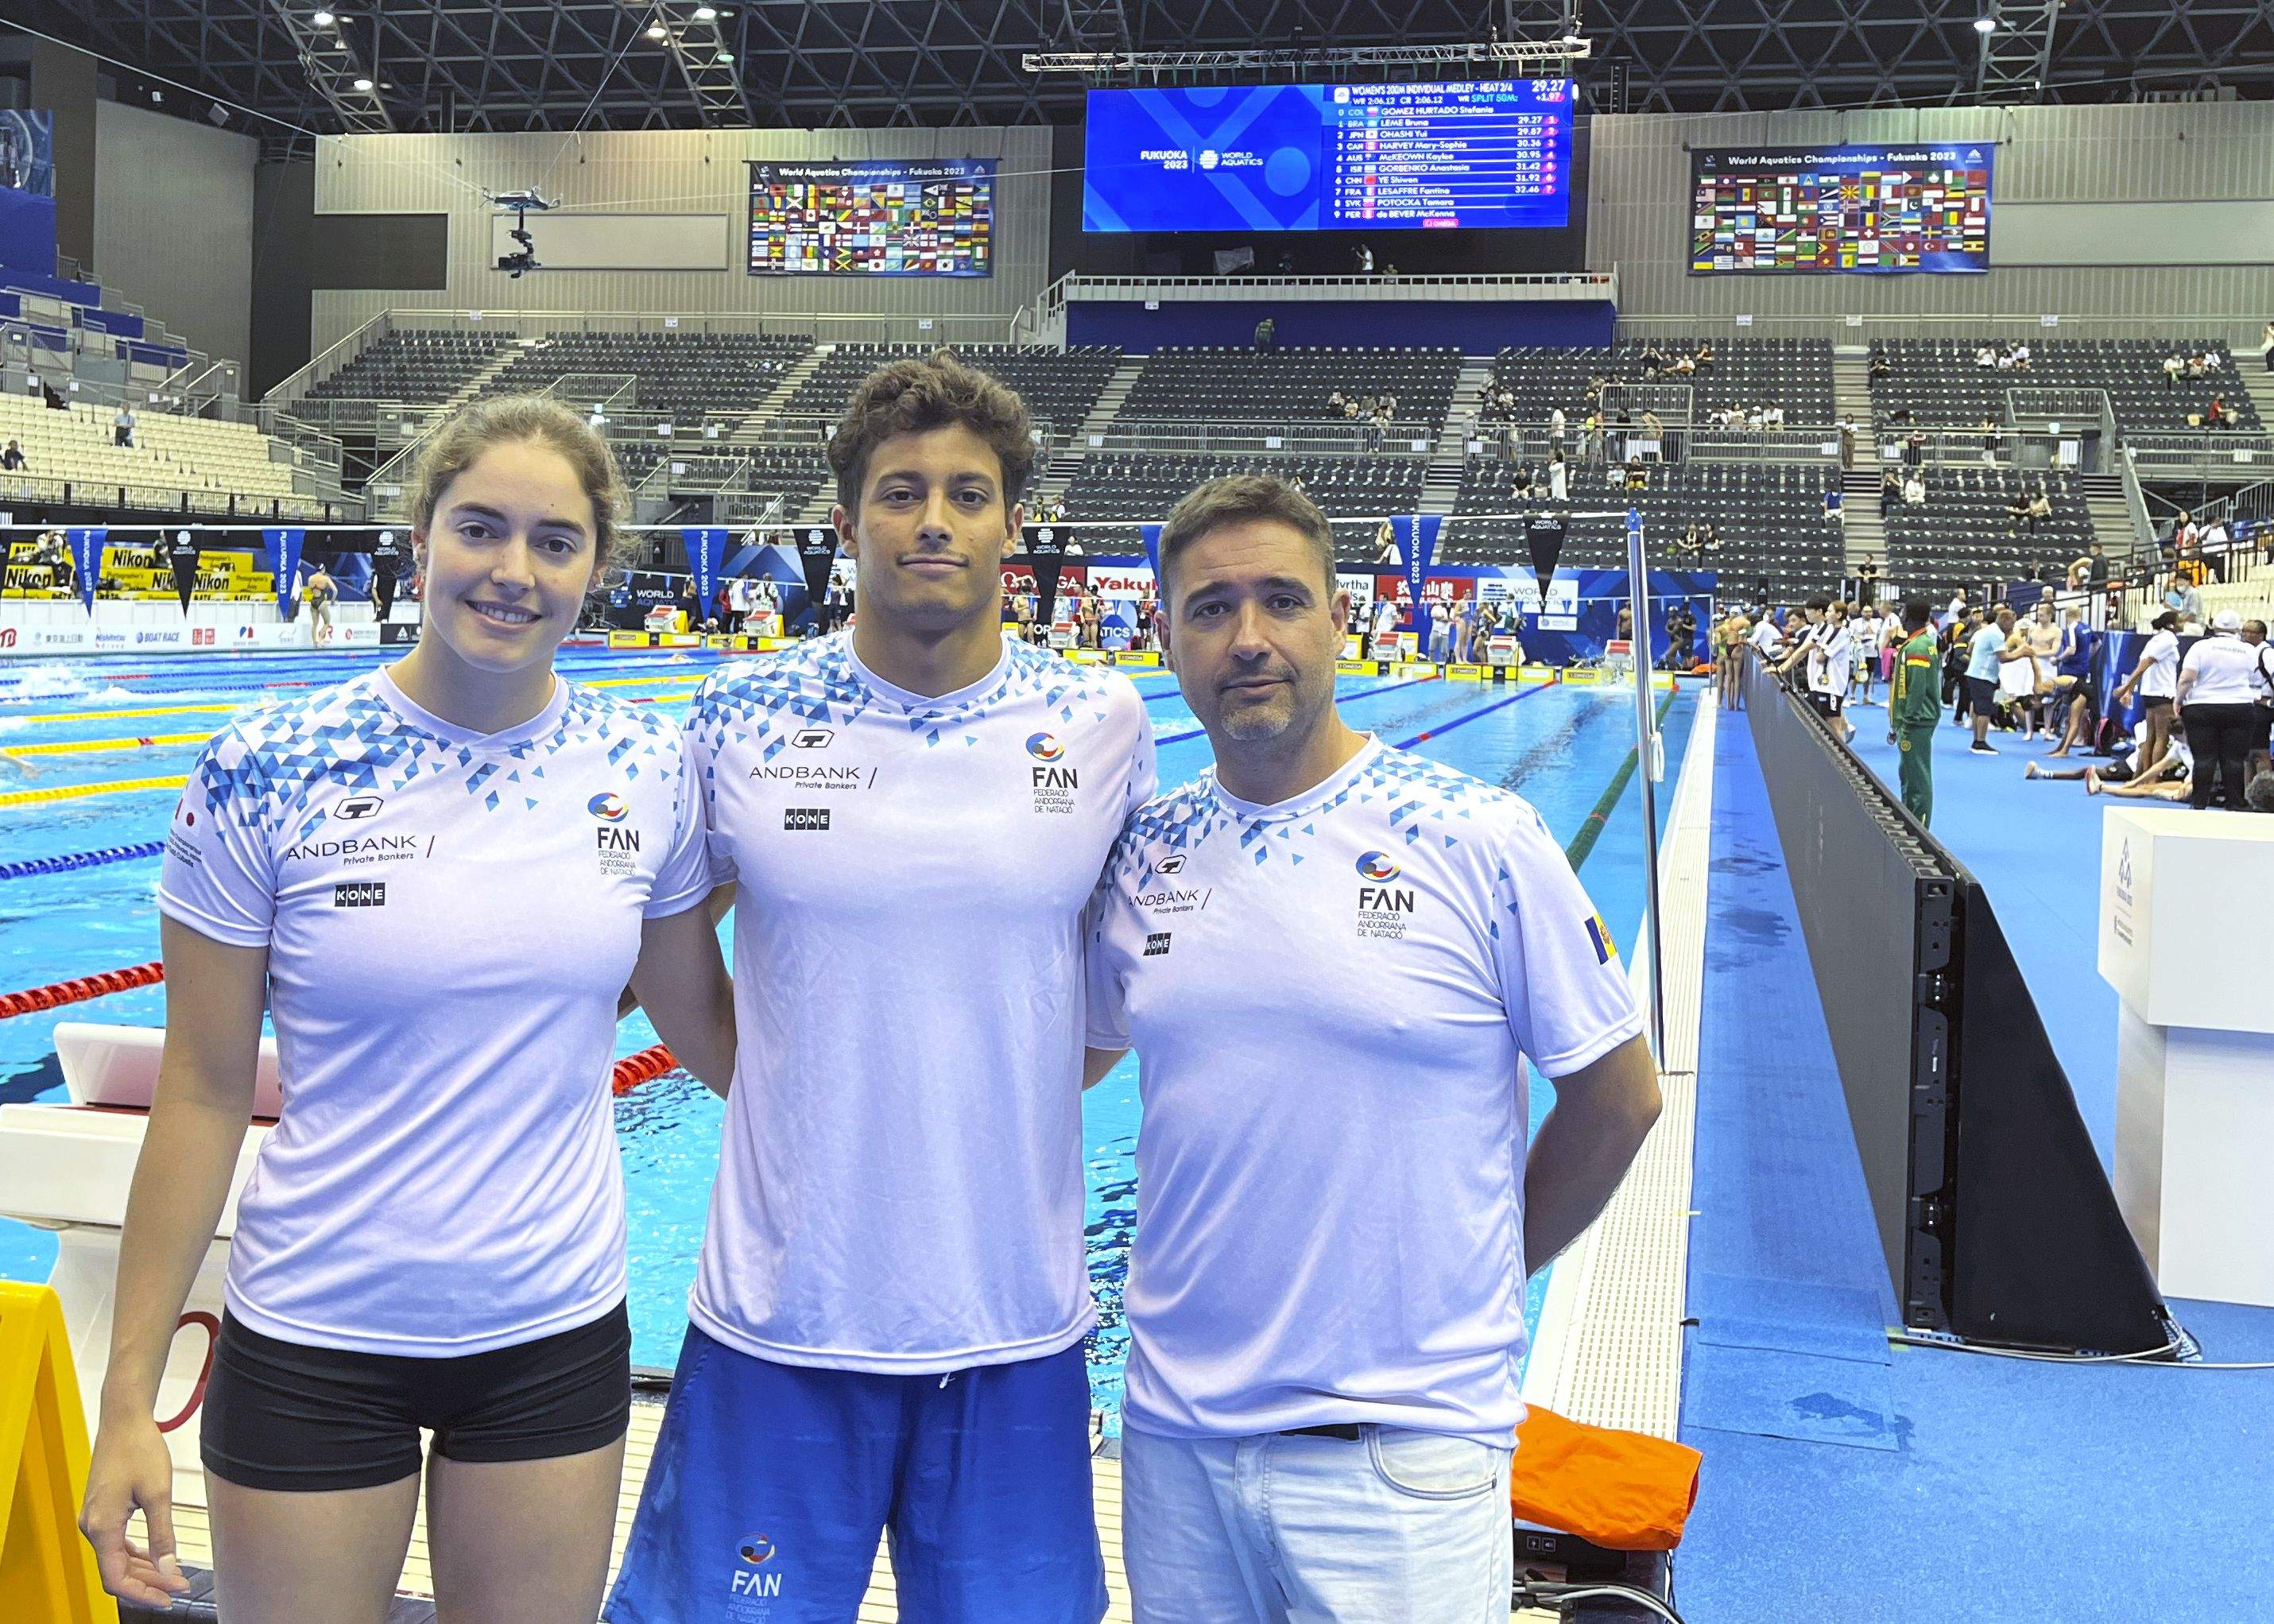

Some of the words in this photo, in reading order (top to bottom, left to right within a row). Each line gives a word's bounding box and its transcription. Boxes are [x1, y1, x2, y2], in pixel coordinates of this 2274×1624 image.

[1447, 83, 1475, 93] MEDLEY
[1480, 83, 1499, 92] HEAT
[1500, 83, 1513, 91] 2/4
[1532, 79, 1565, 91] 29.27
[1471, 94, 1494, 103] SPLIT
[1416, 107, 1459, 115] HURTADO
[1140, 150, 1187, 160] FUKUOKA
[1729, 156, 1757, 165] World
[1760, 156, 1801, 165] Aquatics
[1804, 154, 1877, 165] Championships
[1930, 152, 1956, 161] 2023
[779, 168, 804, 176] World
[805, 169, 839, 177] Aquatics
[842, 168, 901, 177] Championships
[909, 167, 942, 176] Fukuoka
[1164, 161, 1187, 169] 2023
[113, 549, 153, 568] Nikon
[7, 569, 52, 587] Nikon
[193, 573, 229, 590] Nikon
[637, 590, 674, 599] WORLD
[1513, 587, 1558, 596] WORD
[750, 766, 860, 779] ANDBANK
[1032, 766, 1078, 789] FAN
[785, 812, 828, 826] KONE
[598, 827, 639, 851] FAN
[285, 835, 417, 861] ANDBANK
[343, 855, 375, 866] Private
[378, 852, 413, 862] Bankers
[335, 887, 384, 903] KONE
[1129, 890, 1199, 907] ANDBANK
[1359, 888, 1413, 913] FAN
[1358, 920, 1407, 931] ANDORRANA
[1145, 936, 1170, 952] KONE
[731, 1570, 781, 1597] FAN
